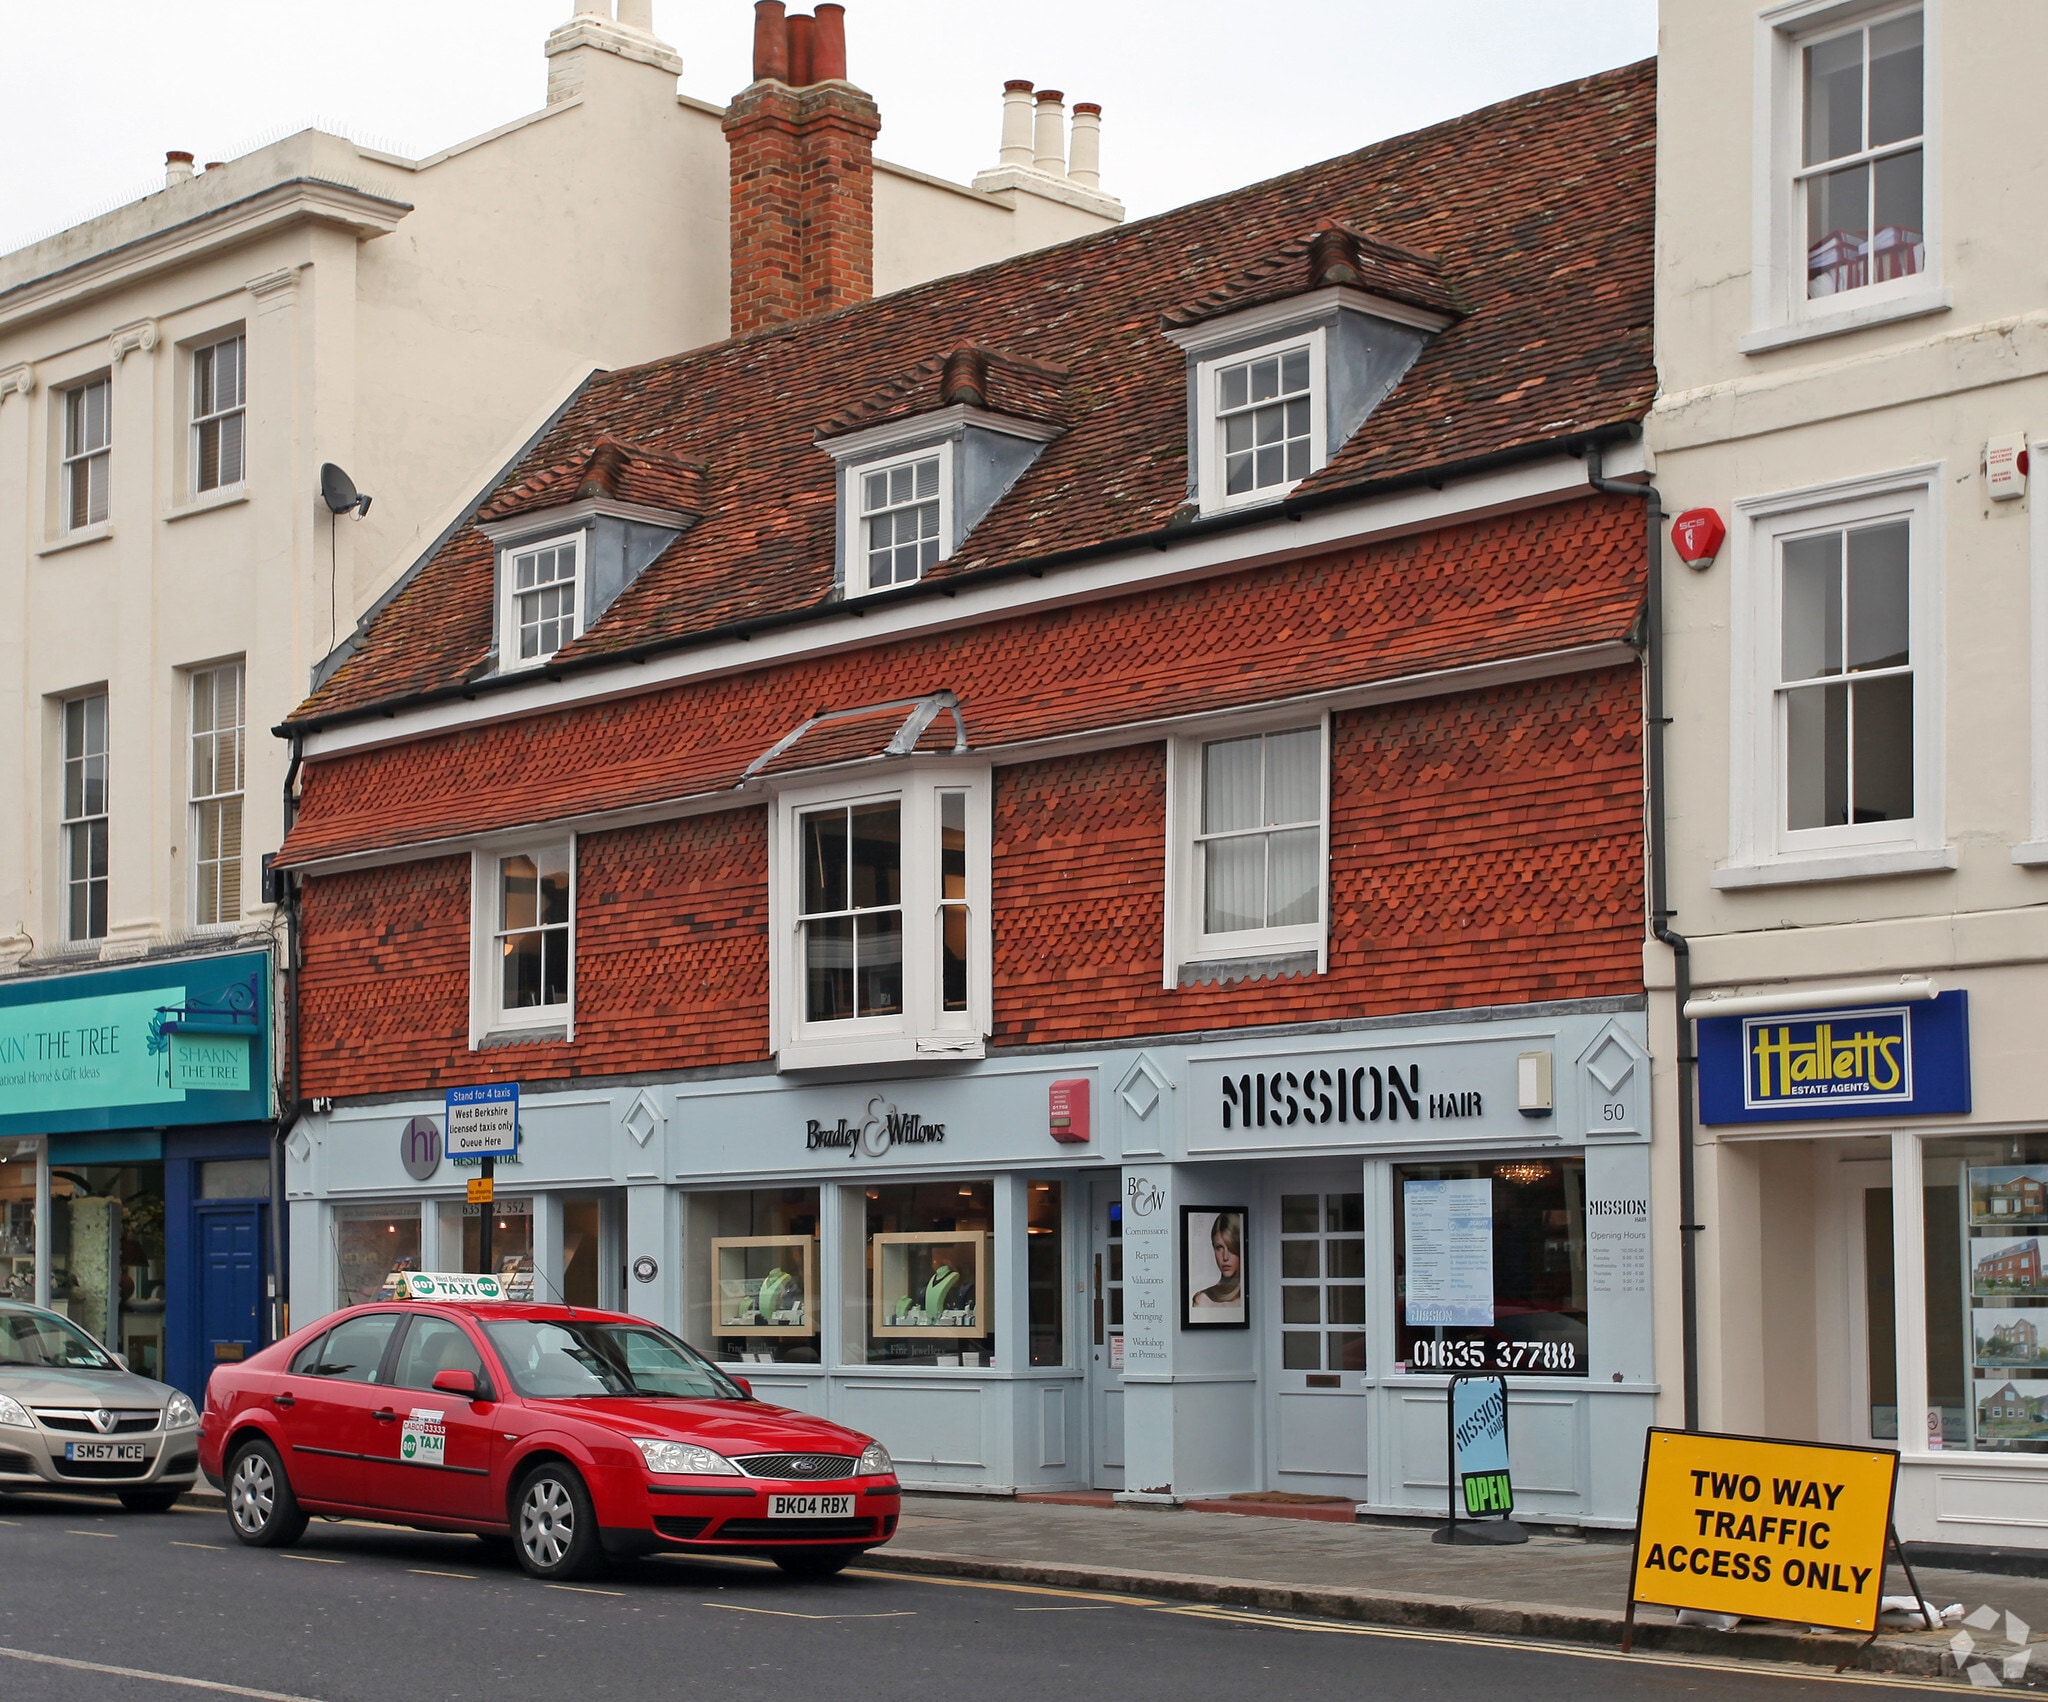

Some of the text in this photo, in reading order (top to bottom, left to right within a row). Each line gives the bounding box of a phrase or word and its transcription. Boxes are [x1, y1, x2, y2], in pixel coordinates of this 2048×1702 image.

[35, 1031, 71, 1060] THE
[76, 1025, 120, 1057] TREE
[179, 1047, 242, 1063] SHAKIN'
[1752, 1024, 1902, 1097] Halletts
[28, 1071, 52, 1083] Home
[54, 1069, 61, 1081] &
[62, 1067, 76, 1081] Gift
[79, 1065, 101, 1080] Ideas
[179, 1064, 239, 1079] THE TREE
[453, 1087, 511, 1101] Stand for 4 taxis
[1791, 1082, 1870, 1095] ESTATE AGENTS
[1222, 1064, 1482, 1129] MISSION HAIR
[455, 1106, 508, 1119] West Berkshire
[1603, 1103, 1625, 1121] 50
[479, 1122, 496, 1132] taxis
[498, 1120, 513, 1132] only
[805, 1092, 946, 1158] Bradley & Willows
[460, 1137, 502, 1148] Queue Here
[506, 1201, 524, 1214] 552
[1589, 1199, 1646, 1215] MISSION
[1125, 1227, 1169, 1235] Commissions
[1591, 1231, 1646, 1241] Opening Hours
[1135, 1251, 1159, 1262] Repairs
[1131, 1276, 1164, 1284] Valuations
[413, 1280, 433, 1289] 807
[437, 1283, 478, 1295] TAXI
[478, 1283, 497, 1292] 807
[1140, 1299, 1155, 1308] Pearl
[1132, 1311, 1163, 1323] Stringing
[1411, 1309, 1453, 1322] MISSION
[890, 1344, 945, 1356] Fine Jewellery
[1132, 1337, 1165, 1349] Workshop
[1138, 1350, 1167, 1359] Premises
[1413, 1339, 1576, 1369] 01635 37788
[424, 1424, 446, 1434] 33333
[403, 1435, 444, 1451] 807 TAXI
[77, 1445, 142, 1459] SM57 WCE
[799, 1462, 813, 1470] Ford
[1464, 1475, 1512, 1513] OPEN
[1690, 1469, 1845, 1511] TWO WAY
[775, 1497, 849, 1514] BK04 RBX
[1694, 1508, 1831, 1550] TRAFFIC
[1644, 1543, 1873, 1594] ACCESS ONLY
